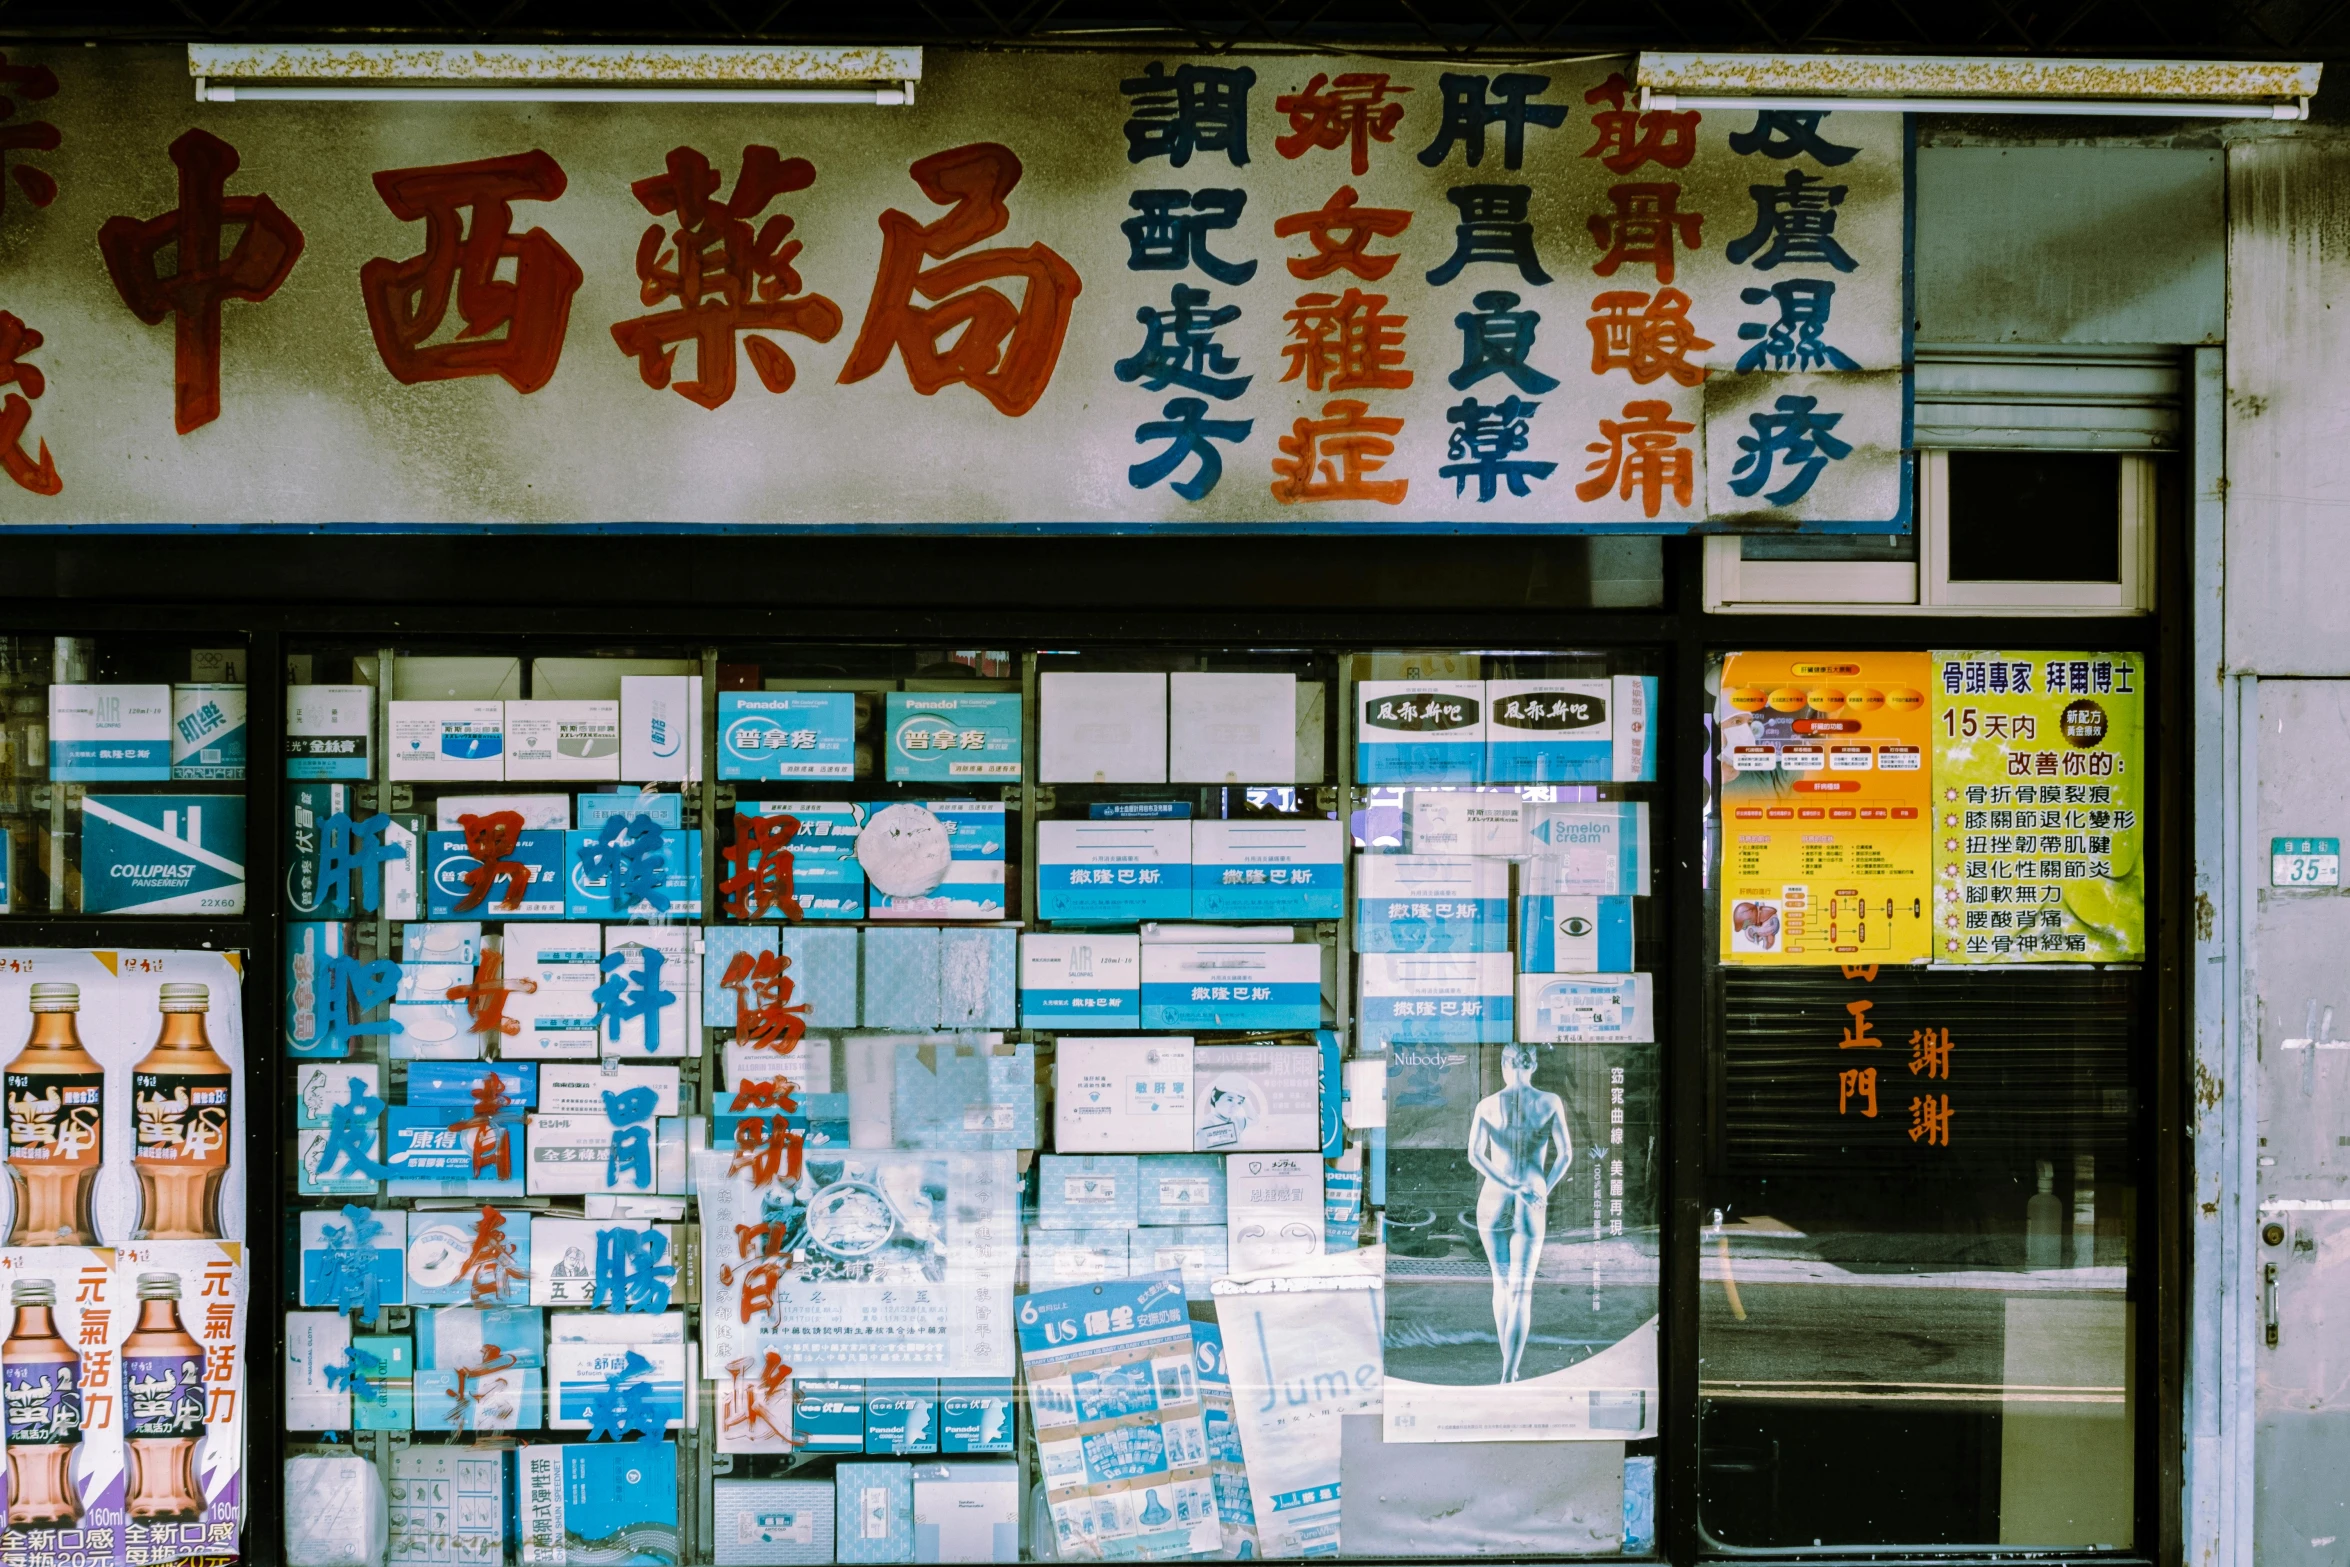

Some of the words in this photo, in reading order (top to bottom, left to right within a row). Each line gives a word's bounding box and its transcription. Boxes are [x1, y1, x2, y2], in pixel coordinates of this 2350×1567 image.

[98, 126, 1083, 435] 中西藥局
[1114, 61, 1258, 501] 調配處方
[1271, 73, 1414, 506] 婦女雜症
[1417, 72, 1569, 503] 肝胃良藥
[1575, 74, 1715, 518] 筋骨酸痛
[1943, 661, 2032, 694] 骨頭專家
[2046, 661, 2134, 694] 拜爾博士
[96, 697, 121, 722] AIR
[737, 700, 789, 710] Panadol
[906, 700, 957, 710] Panadol
[177, 700, 227, 744] 肌樂
[2067, 710, 2101, 725] 新配方
[735, 730, 816, 750] 普拿疼
[904, 730, 985, 750] 普拿疼
[99, 749, 150, 759] 撒隆巴斯
[1965, 785, 2111, 804] 骨折骨膜裂痕
[1556, 821, 1610, 834] Smelon
[1965, 810, 2135, 830] 膝關節退化變形
[1556, 832, 1602, 843] cream
[1965, 835, 2111, 855] 扭挫韌帶肌腱
[2285, 841, 2328, 852] 自由街
[110, 864, 196, 878] COLUPLAST
[1070, 869, 1161, 884] 撒隆巴斯
[1223, 869, 1313, 884] 撒隆巴斯
[1965, 859, 2111, 879] 退化性關節炎
[2291, 858, 2320, 881] 35
[131, 879, 190, 887] PANSEMENT
[201, 899, 235, 908] 22X60
[1965, 885, 2062, 904] 腳軟無力
[1388, 903, 1478, 919] 撒隆巴斯
[1965, 910, 2062, 929] 腰酸背痛
[1965, 934, 2087, 953] 坐骨神經痛
[1069, 946, 1092, 970] AIR
[1072, 998, 1122, 1008] 撒隆巴斯
[1192, 987, 1271, 1001] 撒隆巴斯
[1393, 1000, 1482, 1017] 撒隆巴斯
[738, 1063, 767, 1072] ALLORIN
[768, 1063, 797, 1071] TABLETS
[1394, 1052, 1448, 1069] Nubody
[1907, 1027, 1954, 1146] 謝謝
[1610, 1067, 1625, 1145] 窈窕曲線
[409, 1131, 458, 1149] 康得
[1609, 1159, 1624, 1237] 美麗再現
[1020, 1300, 1038, 1325] 6
[1137, 1308, 1181, 1327] 安撫奶嘴
[1044, 1319, 1077, 1344] US
[75, 1267, 113, 1430] 元氣活力
[201, 1261, 236, 1424] 元氣活力
[378, 1359, 388, 1377] OIL
[378, 1377, 388, 1408] GREEN
[553, 1459, 562, 1502] SPEEDNET
[89, 1509, 123, 1527] 160ml
[554, 1506, 563, 1528] SHUN
[1, 1530, 115, 1551] 全新口感
[125, 1523, 235, 1543] 全新口感
